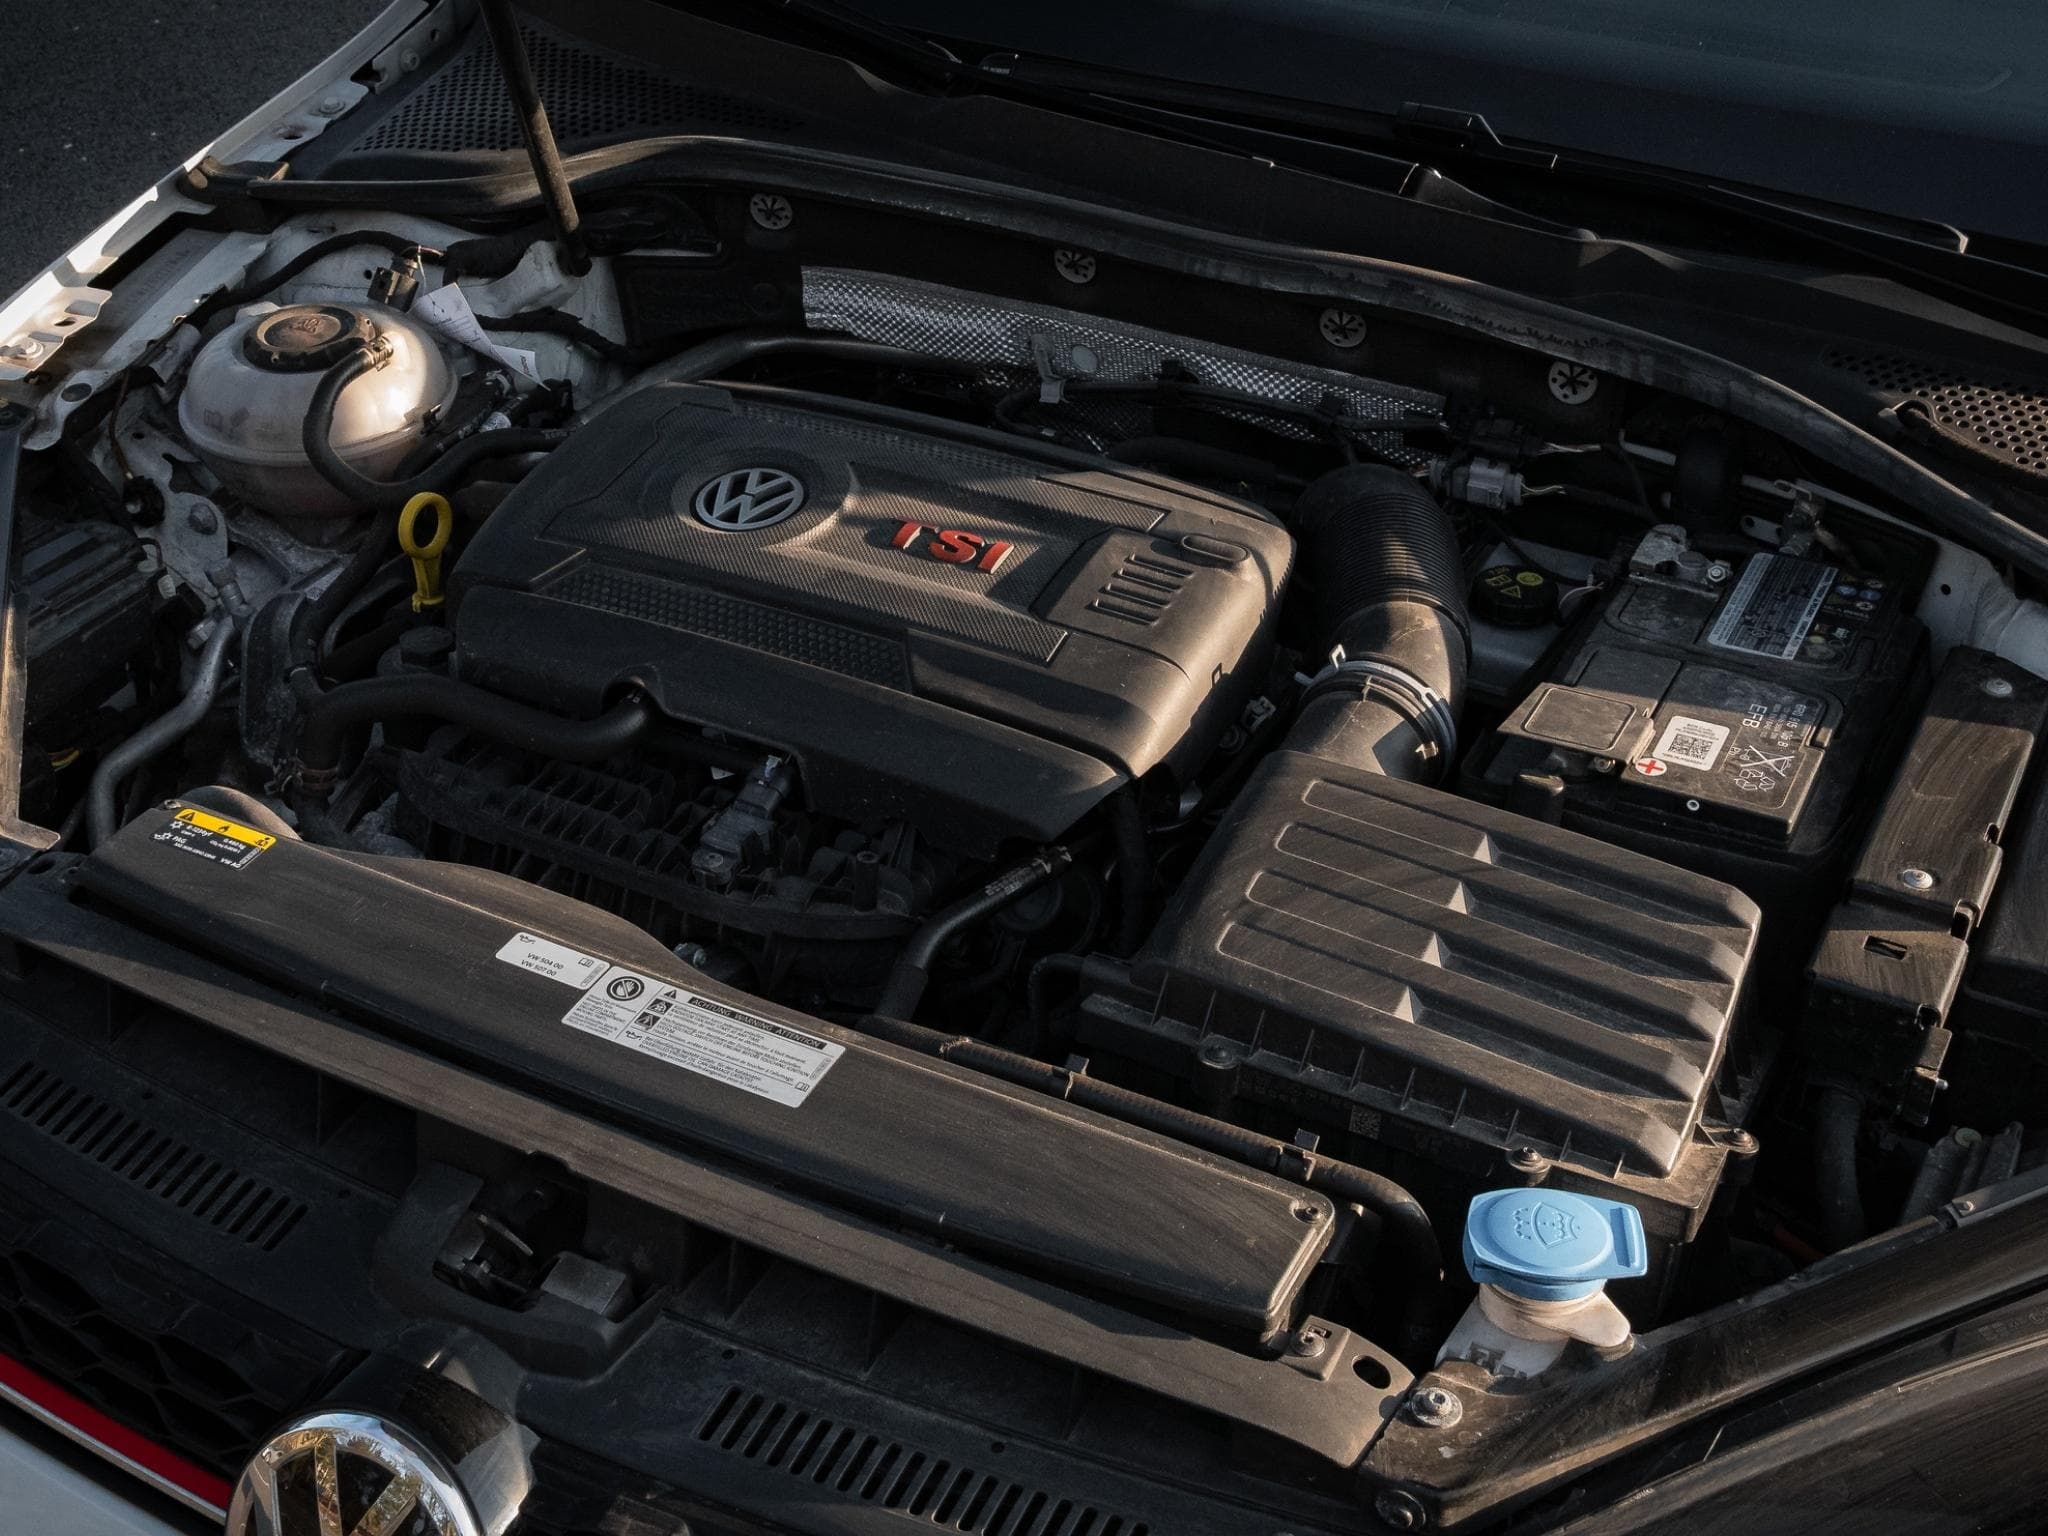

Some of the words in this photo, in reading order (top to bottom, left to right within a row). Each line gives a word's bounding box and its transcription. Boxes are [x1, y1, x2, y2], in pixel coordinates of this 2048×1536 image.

[891, 518, 1015, 575] TSI
[1742, 703, 1768, 728] EFB
[521, 959, 534, 968] VW
[546, 968, 557, 976] 00
[527, 952, 540, 961] VW
[541, 957, 554, 966] 504
[553, 962, 564, 970] 00
[690, 998, 733, 1016] ACHTUNG
[732, 1012, 774, 1031] WARNING
[774, 1027, 821, 1047] ATTENTION
